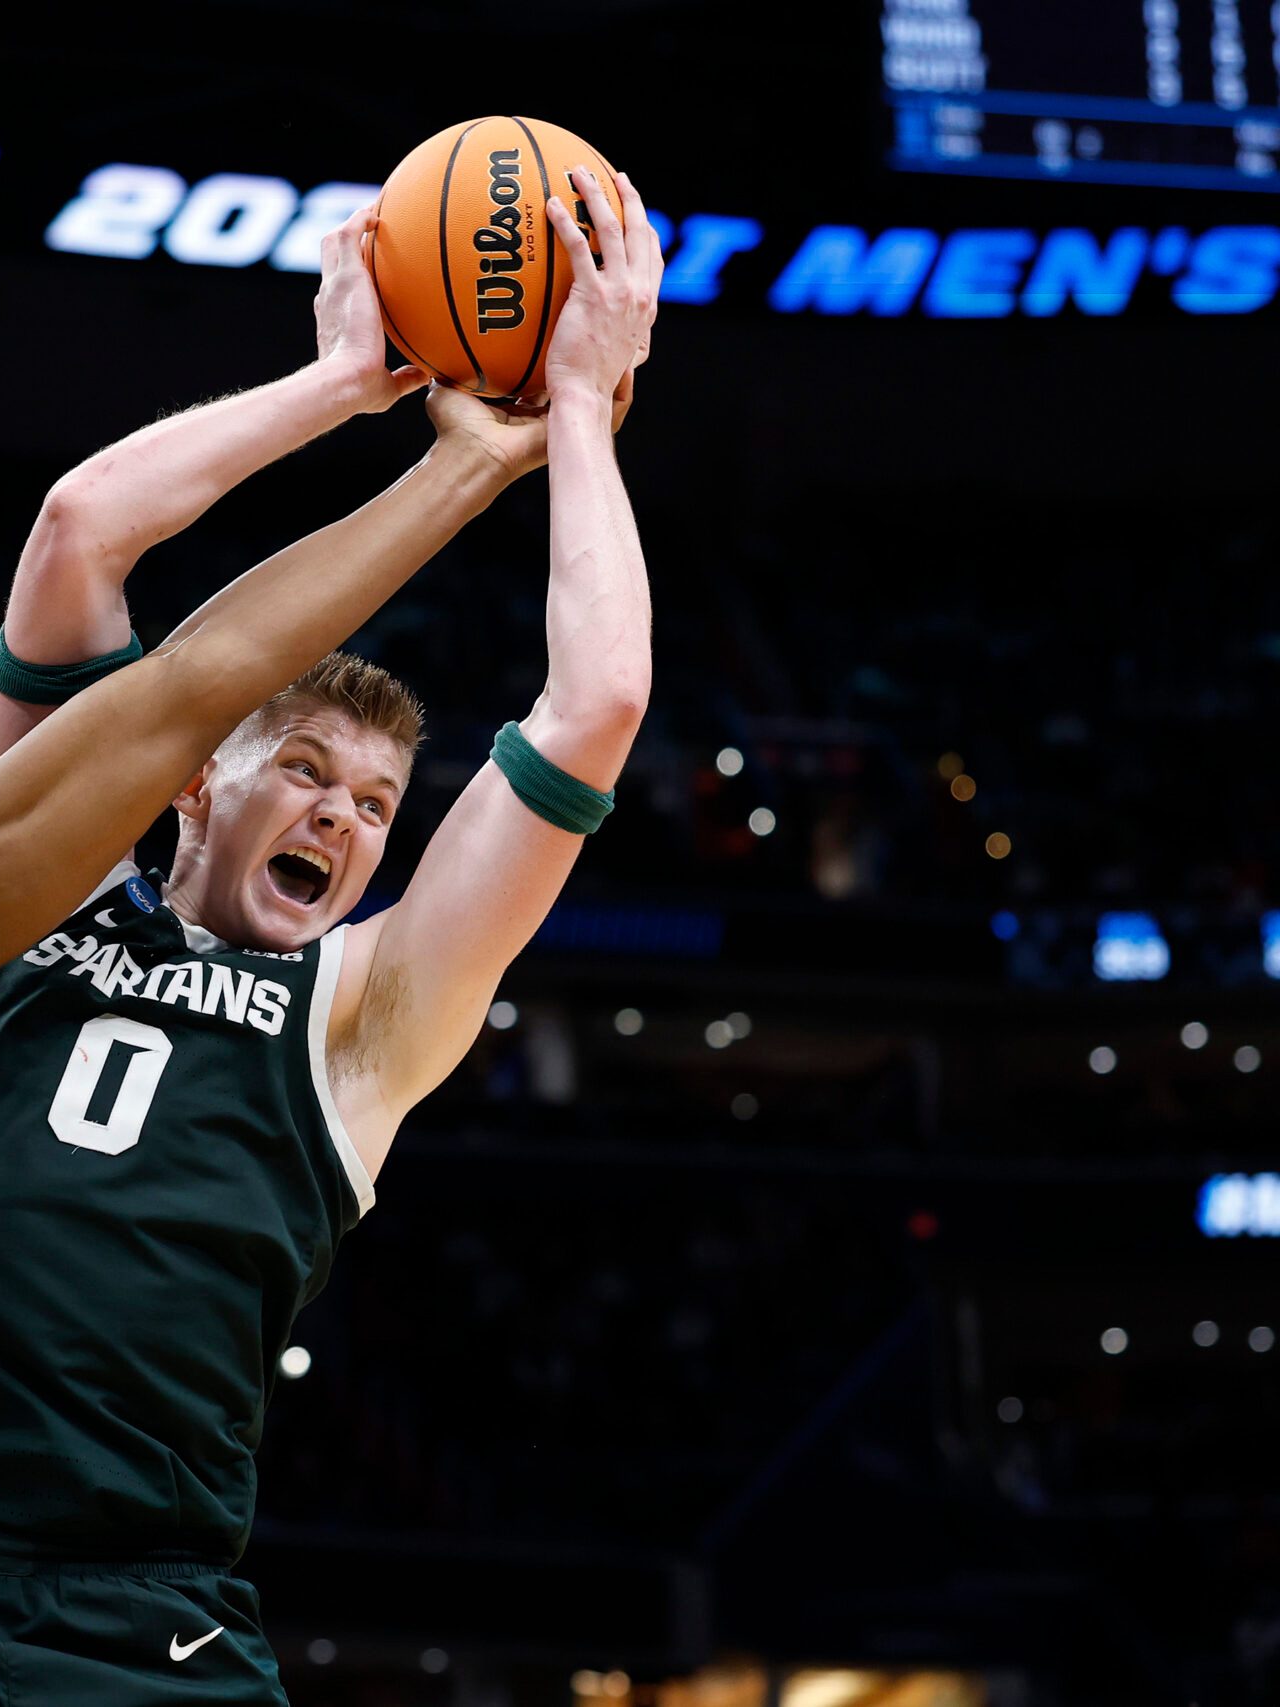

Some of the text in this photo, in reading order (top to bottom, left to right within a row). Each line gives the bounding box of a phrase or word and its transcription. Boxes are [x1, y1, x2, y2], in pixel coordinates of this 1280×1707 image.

[47, 163, 381, 273] 202
[767, 223, 1280, 318] MEN'S
[473, 147, 526, 335] Wilson
[525, 202, 536, 262] EVO NXT
[129, 883, 155, 912] NCAA
[22, 931, 292, 1037] SPARTANS
[47, 1014, 174, 1156] 0
